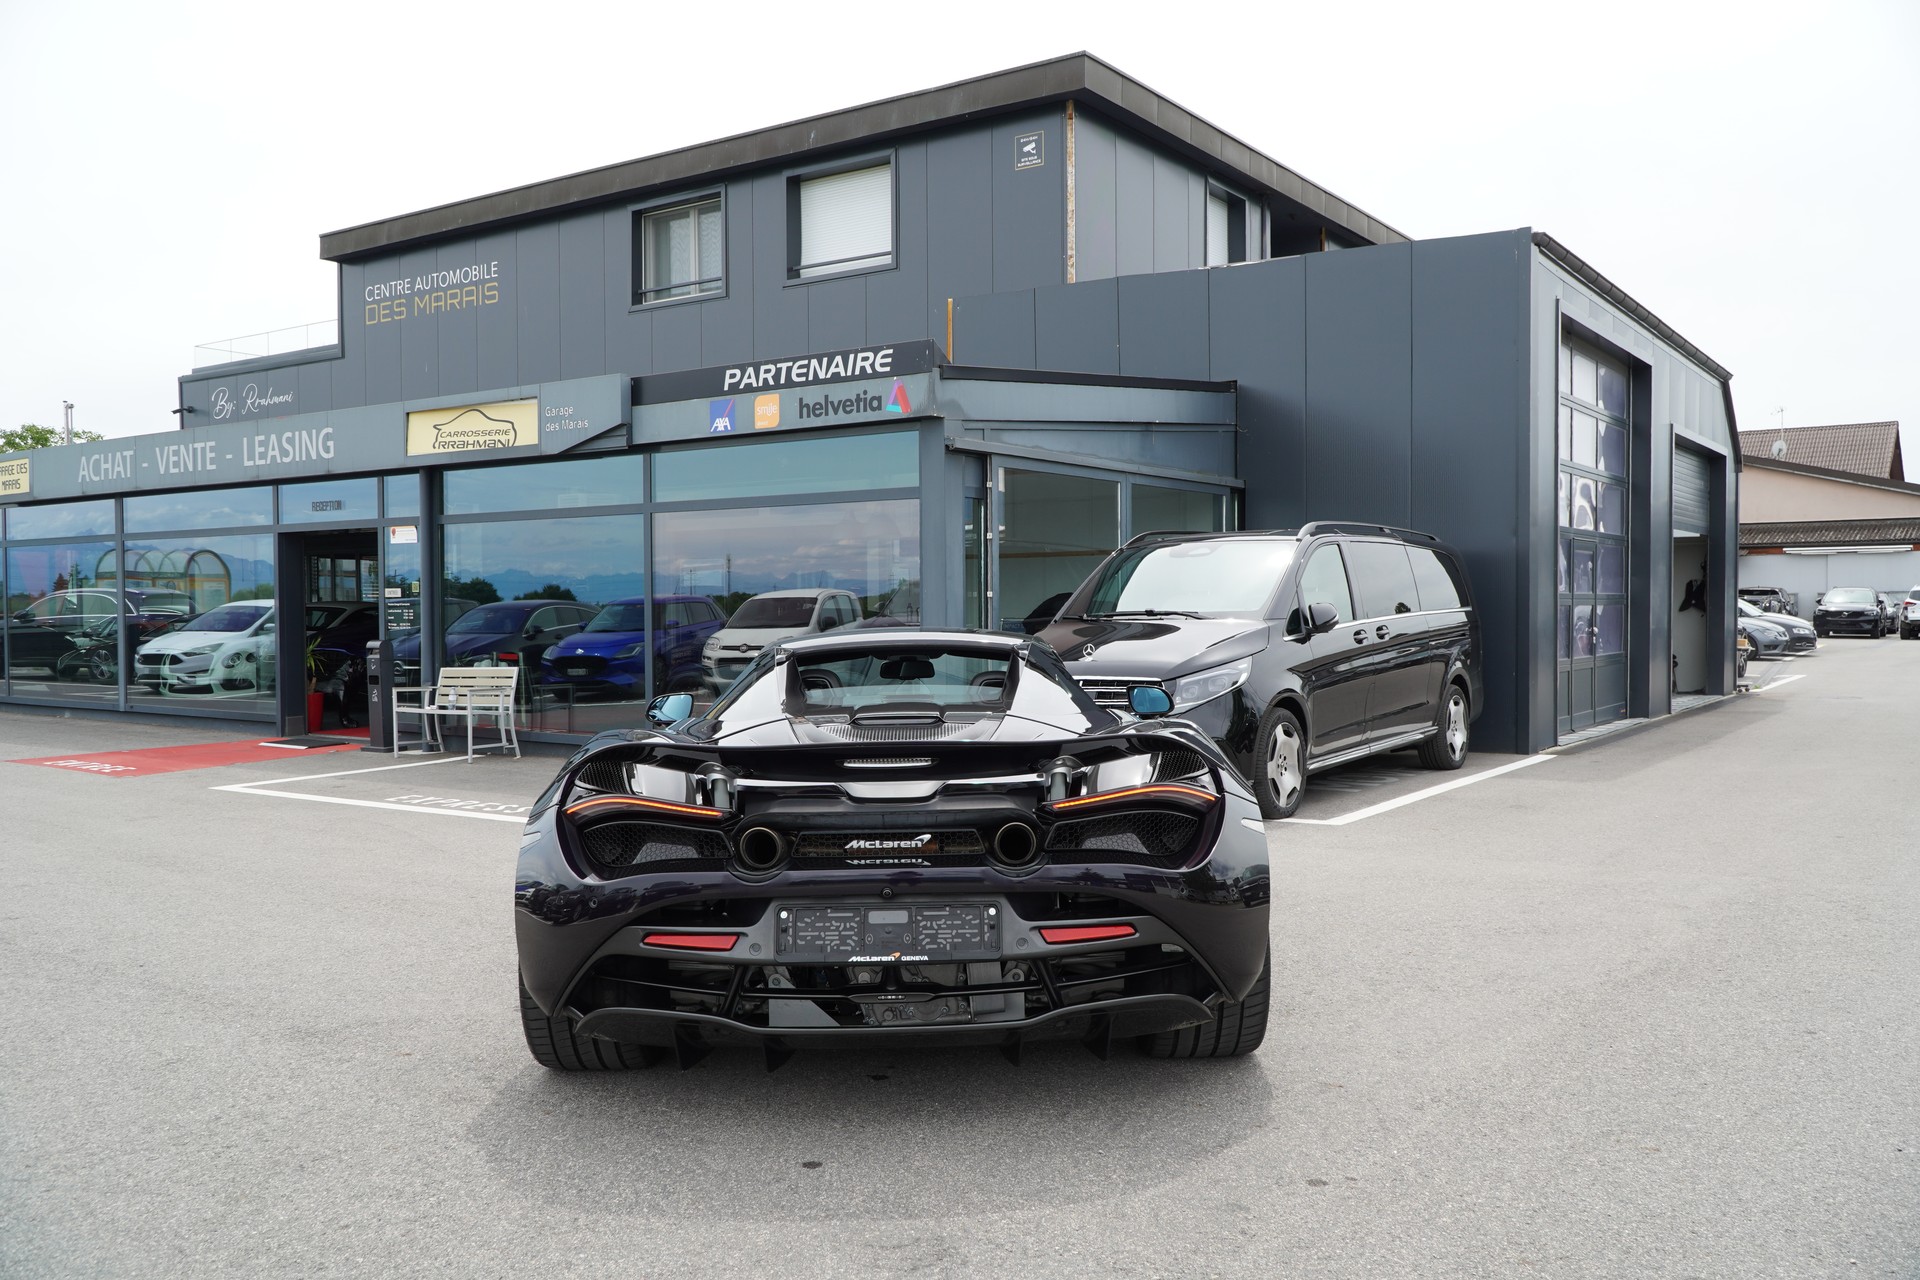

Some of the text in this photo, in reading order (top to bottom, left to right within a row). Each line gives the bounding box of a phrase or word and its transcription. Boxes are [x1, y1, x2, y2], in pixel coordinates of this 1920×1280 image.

[365, 261, 499, 301] CENTRE AUTOMOBILE
[365, 282, 499, 325] DES MARAIS
[723, 348, 894, 391] PARTENAIRE
[545, 405, 574, 417] Garage
[757, 402, 777, 417] smile
[799, 389, 883, 420] helvetia
[545, 418, 589, 432] des Marais
[710, 416, 731, 432] AXA
[440, 428, 511, 439] CARROSSERIE
[78, 450, 134, 483] ACHAT
[155, 441, 217, 475] VENTE
[243, 427, 335, 467] LEASING
[845, 838, 923, 850] McLaren
